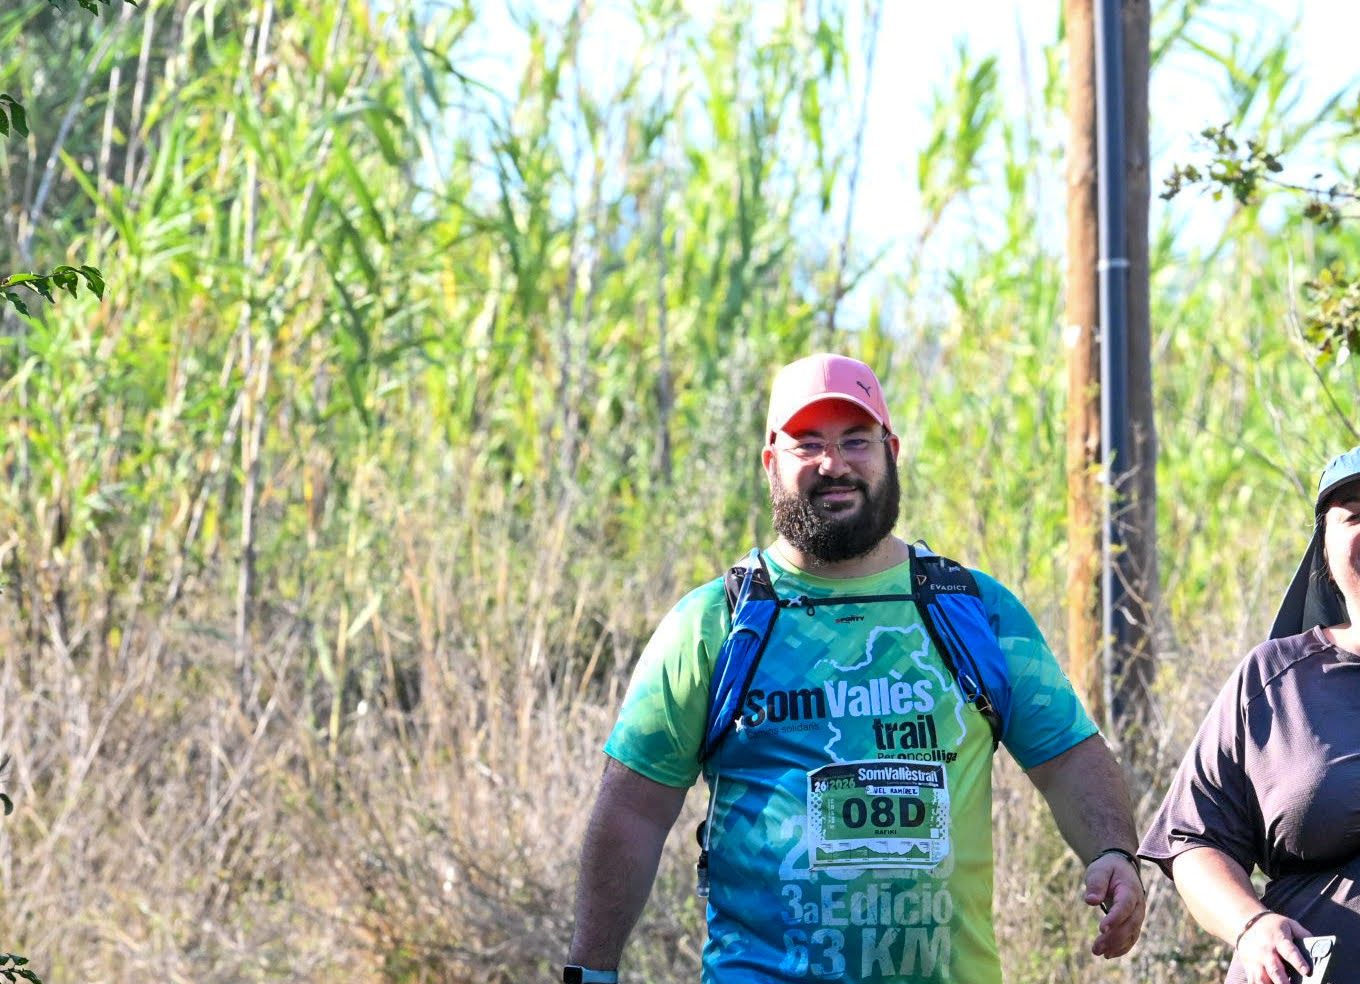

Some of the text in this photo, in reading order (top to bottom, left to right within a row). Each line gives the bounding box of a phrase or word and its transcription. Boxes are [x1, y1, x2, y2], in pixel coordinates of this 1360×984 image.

[872, 714, 938, 750] trail
[858, 766, 938, 782] SomVallèstrail
[842, 797, 925, 828] 08D
[861, 926, 951, 979] KM
